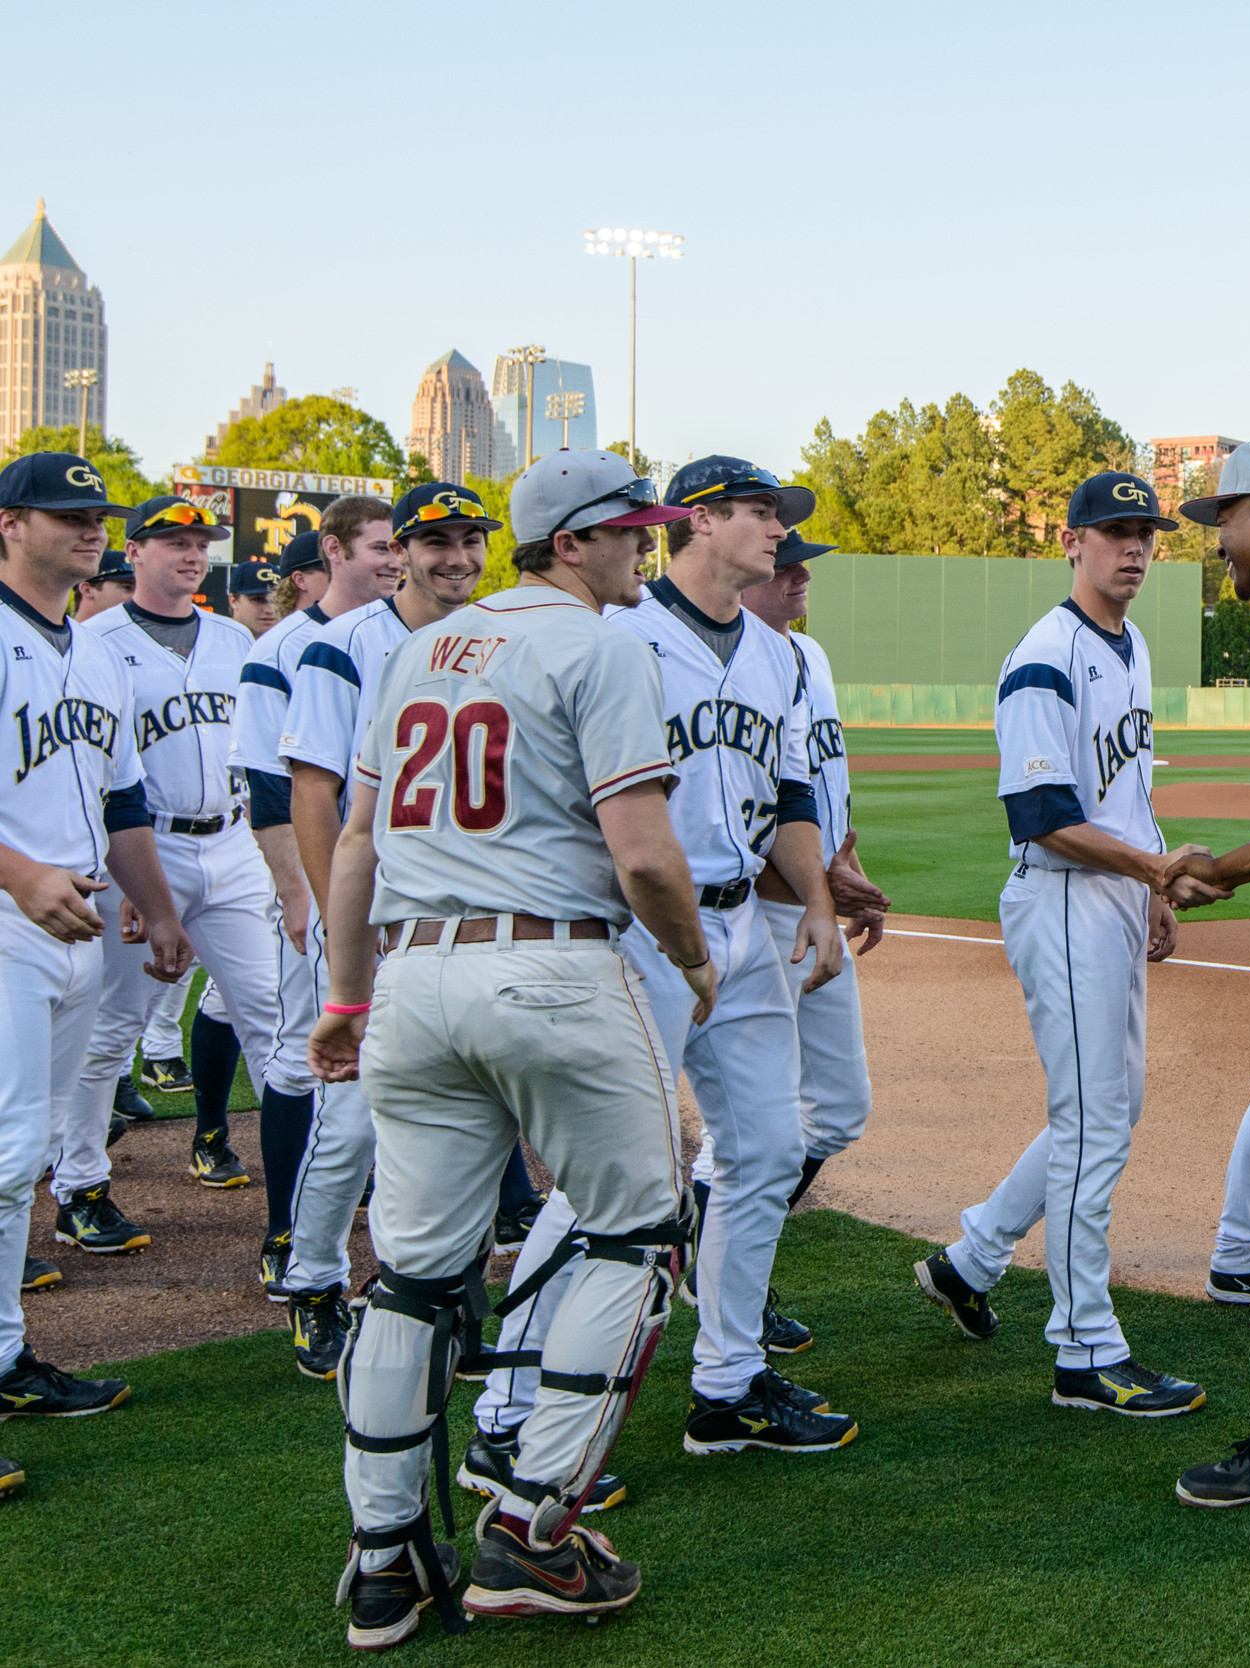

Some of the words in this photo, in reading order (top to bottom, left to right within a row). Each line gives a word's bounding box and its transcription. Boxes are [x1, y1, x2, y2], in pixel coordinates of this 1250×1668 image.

[66, 466, 103, 493] GT
[211, 468, 306, 491] GEORGIA
[314, 475, 368, 495] TECH
[1112, 482, 1149, 507] GT
[257, 568, 281, 585] GT
[429, 635, 508, 676] WEST
[13, 697, 121, 786] JACKET
[139, 692, 237, 754] ACKE
[664, 698, 785, 791] ACKETS
[386, 695, 517, 836] 20
[1092, 707, 1153, 804] JACKE
